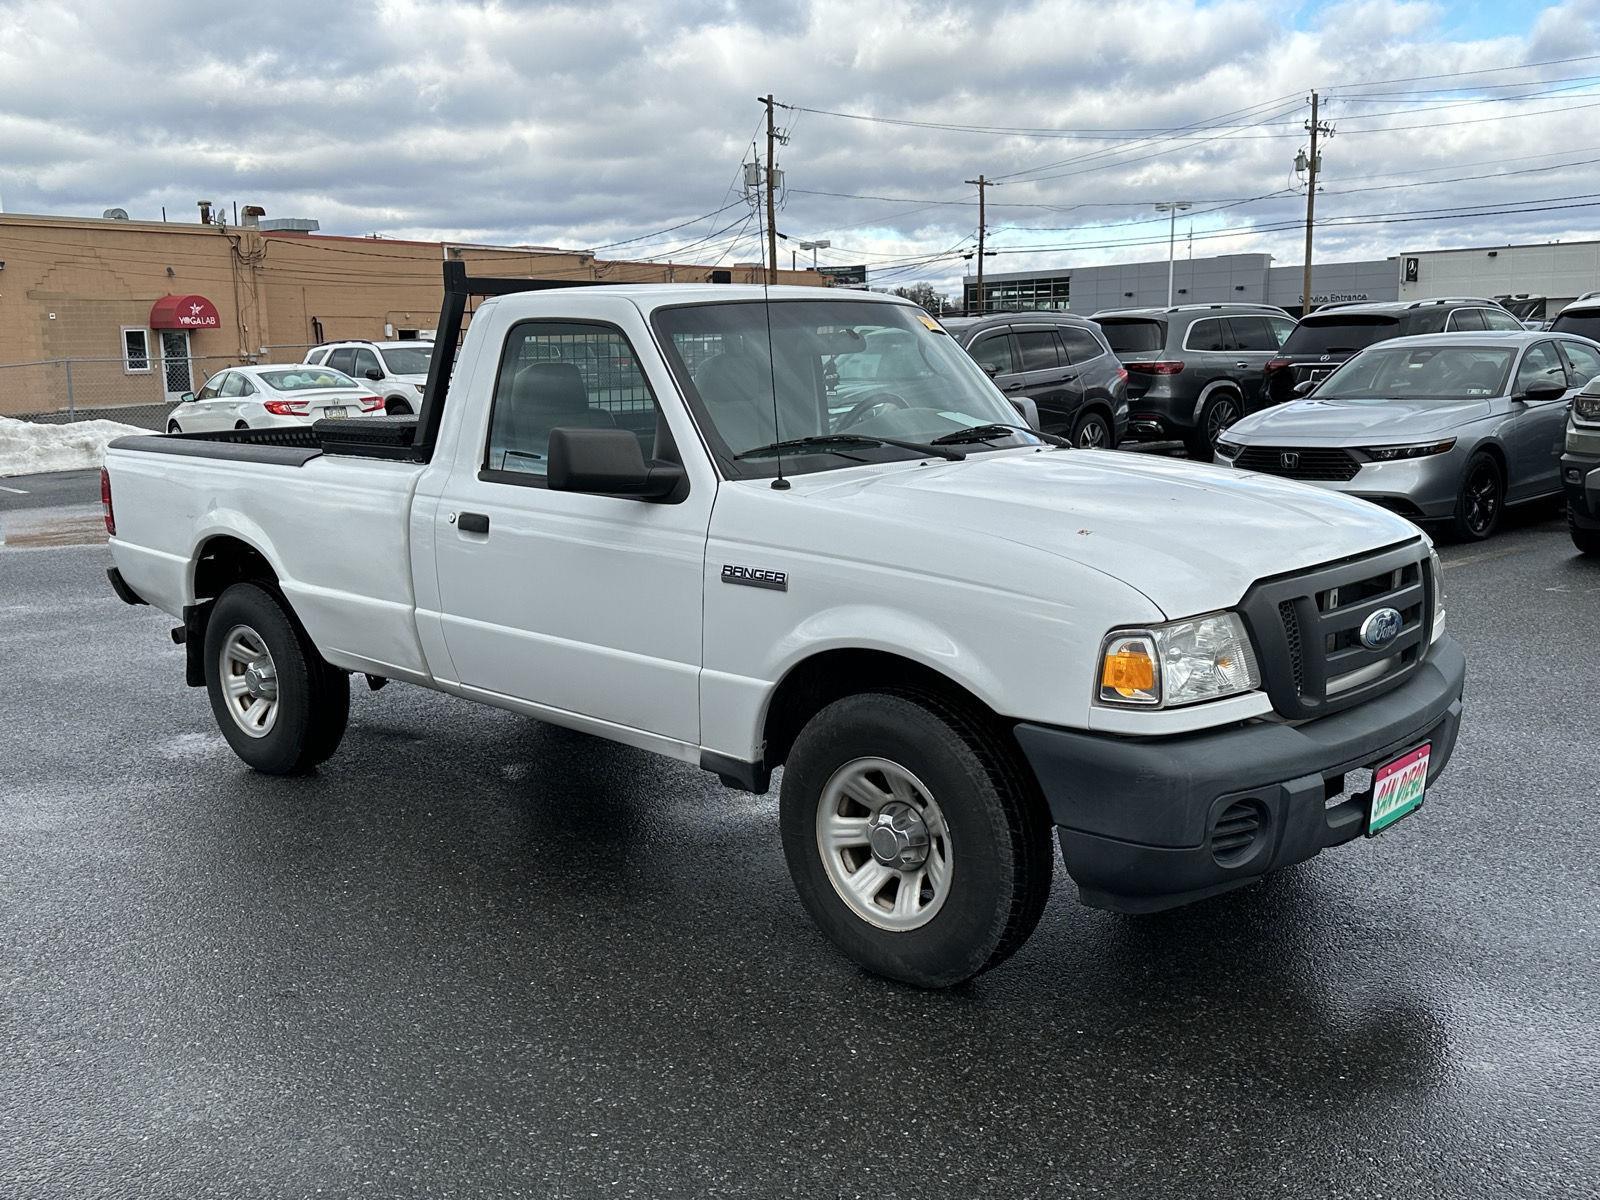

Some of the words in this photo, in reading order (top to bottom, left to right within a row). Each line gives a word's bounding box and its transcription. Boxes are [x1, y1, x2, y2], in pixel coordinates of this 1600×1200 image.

[1298, 293, 1329, 304] Svice
[1330, 293, 1368, 303] Entrance
[721, 564, 787, 585] RANGER
[1375, 616, 1399, 641] Ford
[1374, 777, 1400, 818] SAN
[1395, 761, 1427, 805] DIEGO
